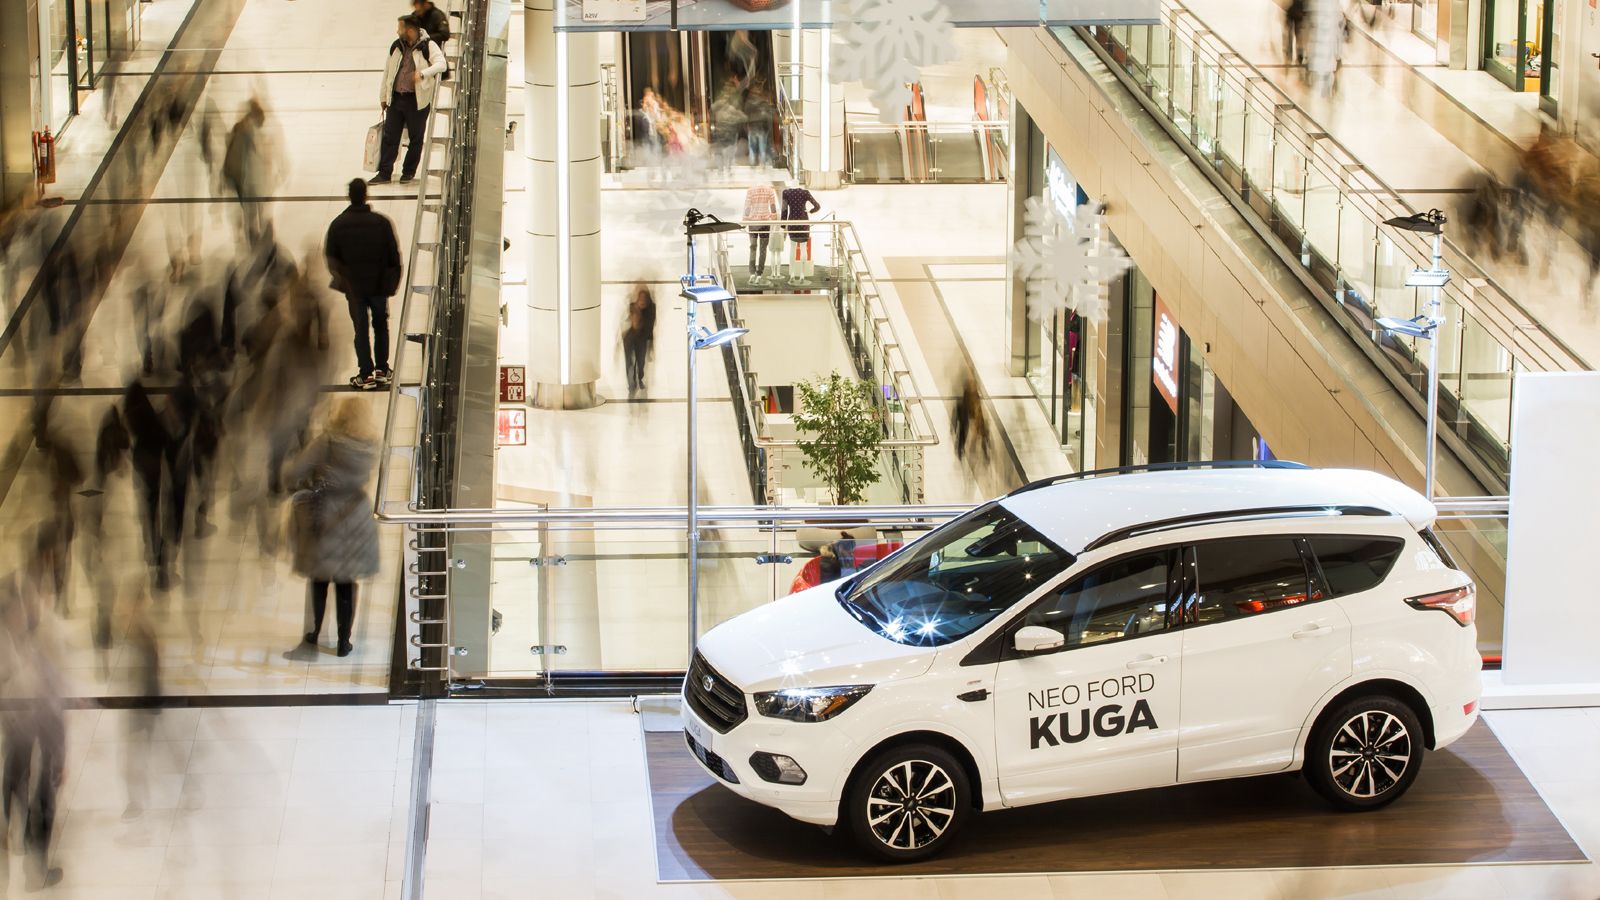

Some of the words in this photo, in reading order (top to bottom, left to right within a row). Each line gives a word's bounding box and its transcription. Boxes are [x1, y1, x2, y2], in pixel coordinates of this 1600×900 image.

[1028, 685, 1080, 711] NEO
[1087, 673, 1155, 701] FORD
[1030, 699, 1158, 749] KUGA
